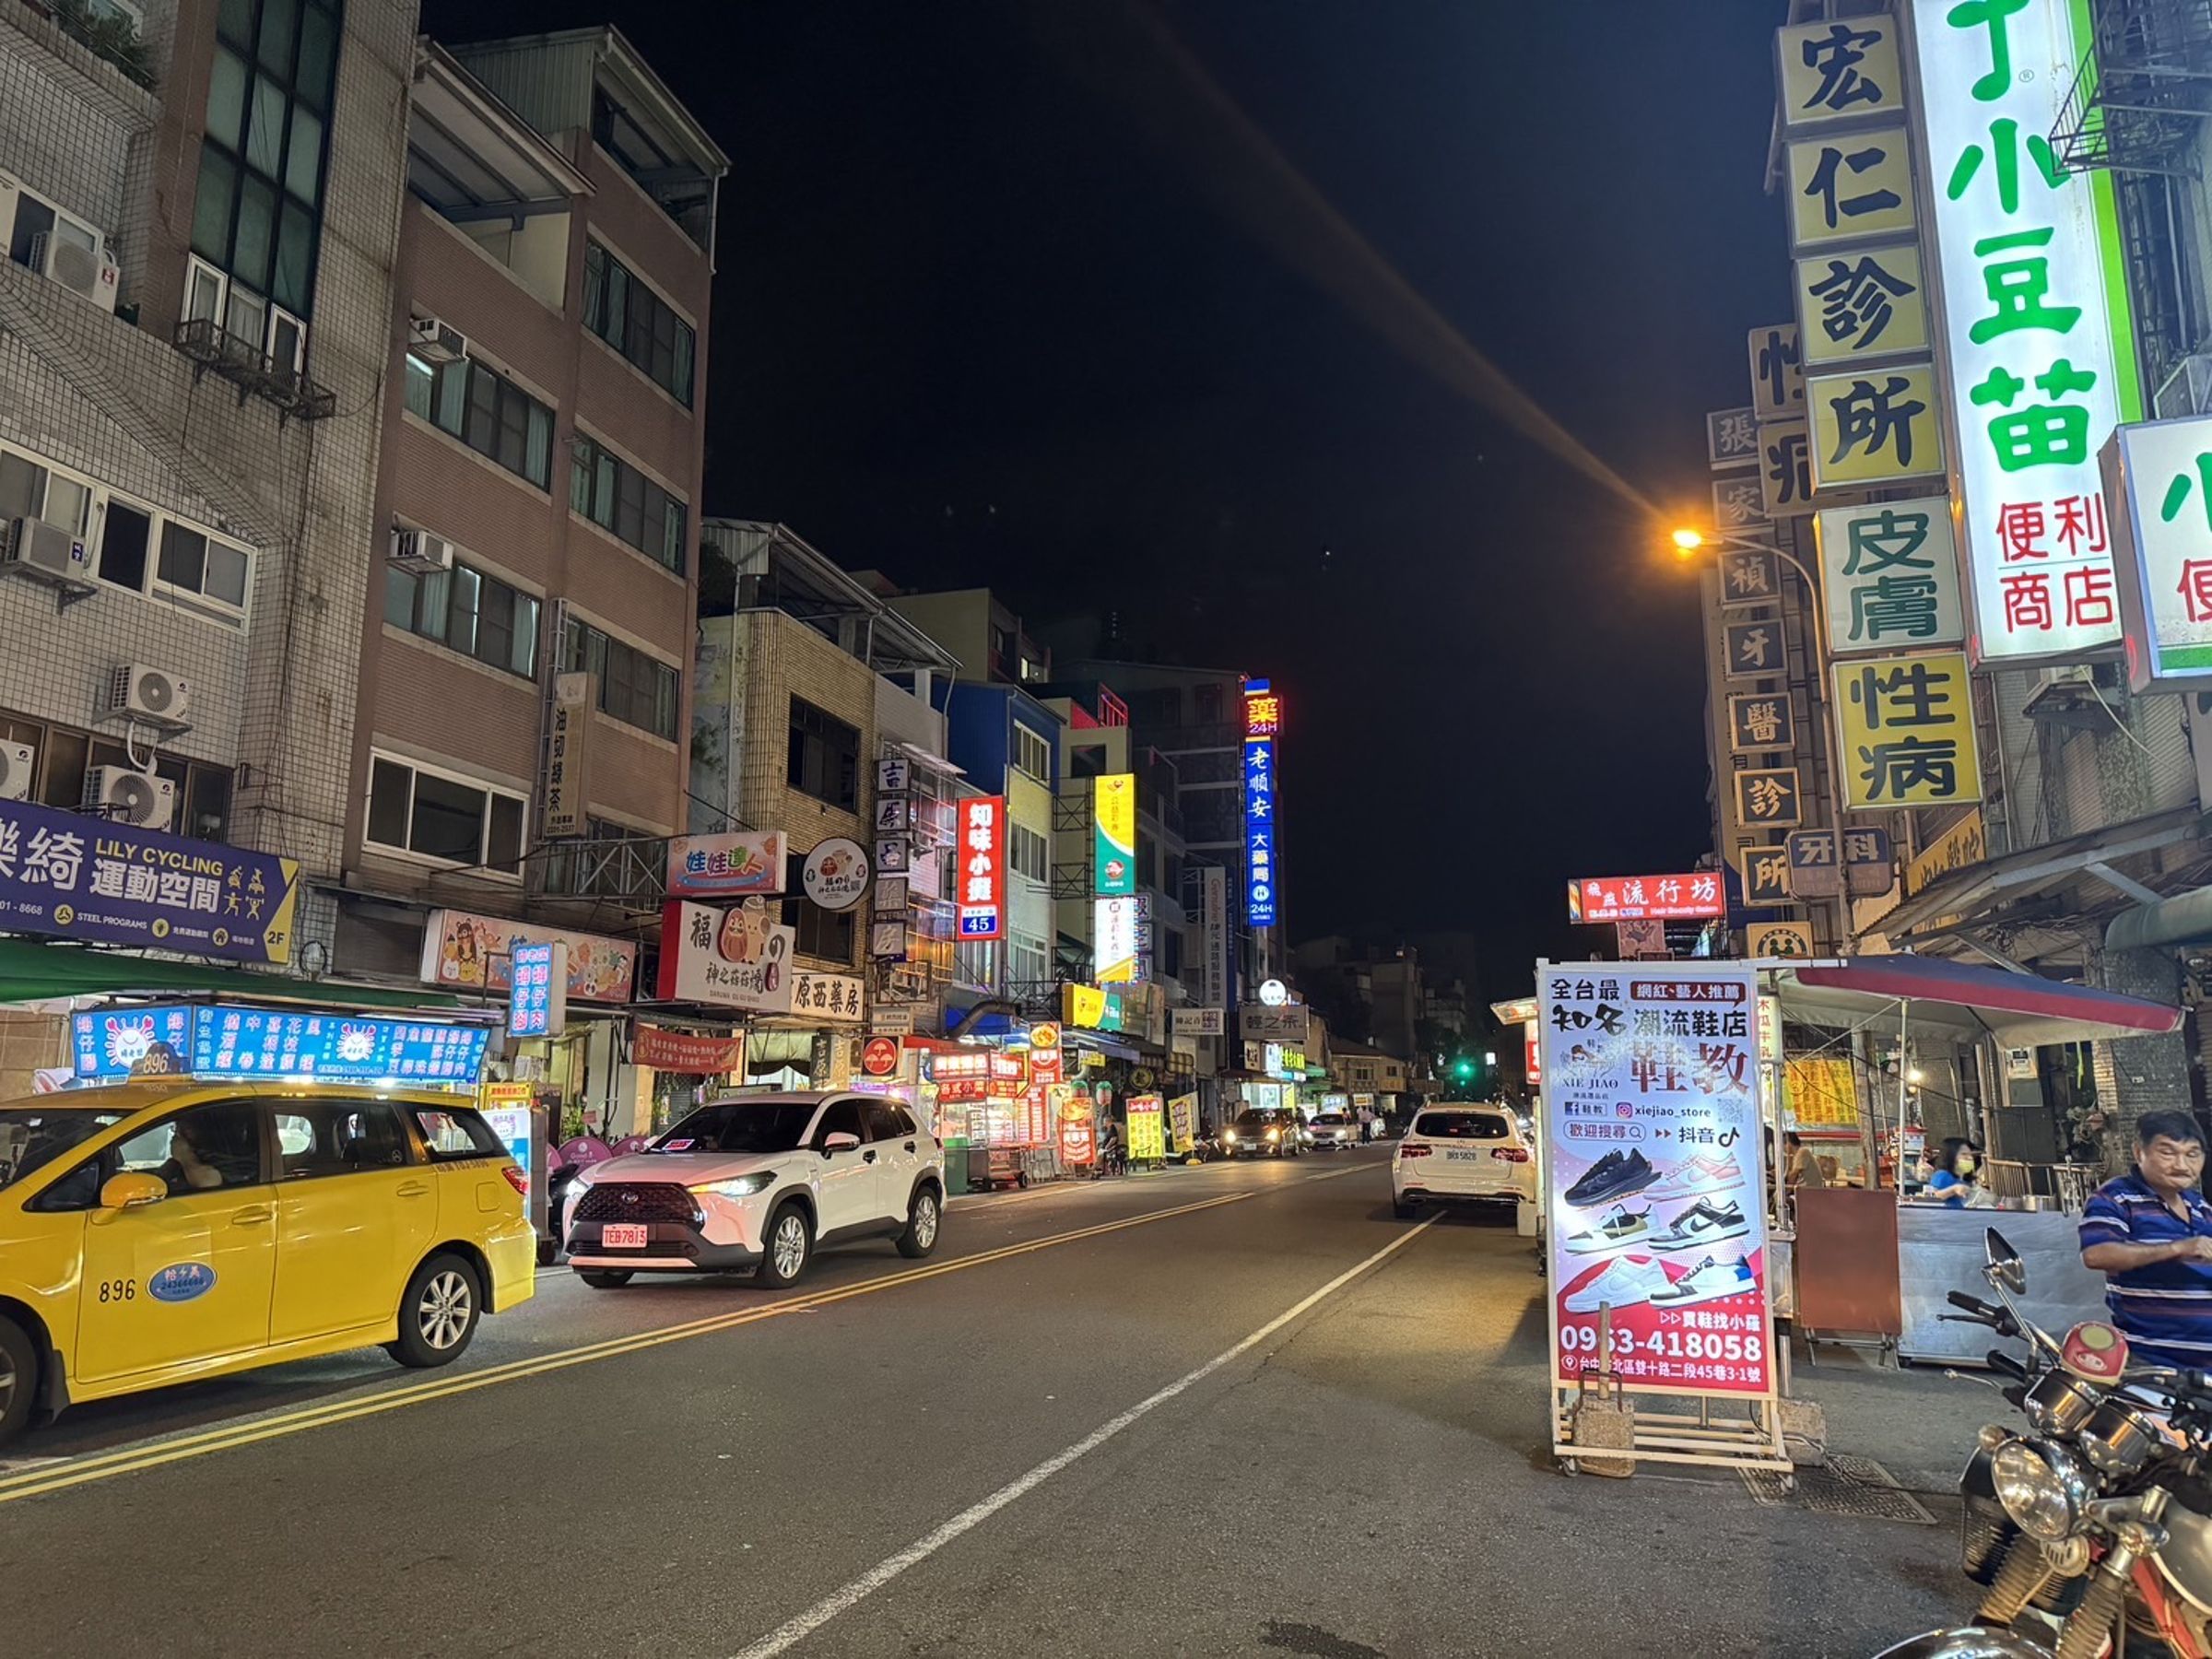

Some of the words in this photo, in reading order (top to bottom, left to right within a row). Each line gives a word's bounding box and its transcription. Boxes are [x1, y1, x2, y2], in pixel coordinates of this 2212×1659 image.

[1996, 492, 2107, 562] 便利
[1842, 510, 1938, 643] 皮膚
[2000, 566, 2113, 633] 商店
[1249, 723, 1277, 734] 24H
[1851, 663, 1957, 801] 性病
[1248, 747, 1272, 818] 老順安
[95, 838, 138, 861] LILY
[142, 847, 224, 877] CYCLING
[686, 845, 764, 876] 娃娃達人
[1798, 832, 1879, 865] 牙科
[89, 857, 222, 913] 運動空間
[1622, 877, 1716, 906] 流行坊
[77, 912, 101, 924] STEEL
[102, 915, 147, 931] PROGRAMS
[1251, 903, 1272, 913] 24H
[267, 931, 284, 945] 2F
[690, 912, 712, 951] 福
[969, 917, 989, 931] 45
[791, 976, 860, 1016] 原西藥房
[1551, 979, 1620, 1001] 全台最
[1551, 1003, 1627, 1036] 知名
[1634, 1008, 1748, 1038] 潮流鞋店
[143, 1053, 170, 1073] 896
[1630, 1041, 1749, 1095] 鞋教
[1562, 1078, 1584, 1088] XIE
[1589, 1078, 1618, 1089] JIAO
[1635, 1105, 1712, 1118] xiejiao_store
[1570, 1124, 1627, 1138] 歡迎搜尋
[1678, 1127, 1714, 1144] 抖音
[100, 1279, 135, 1303] 896
